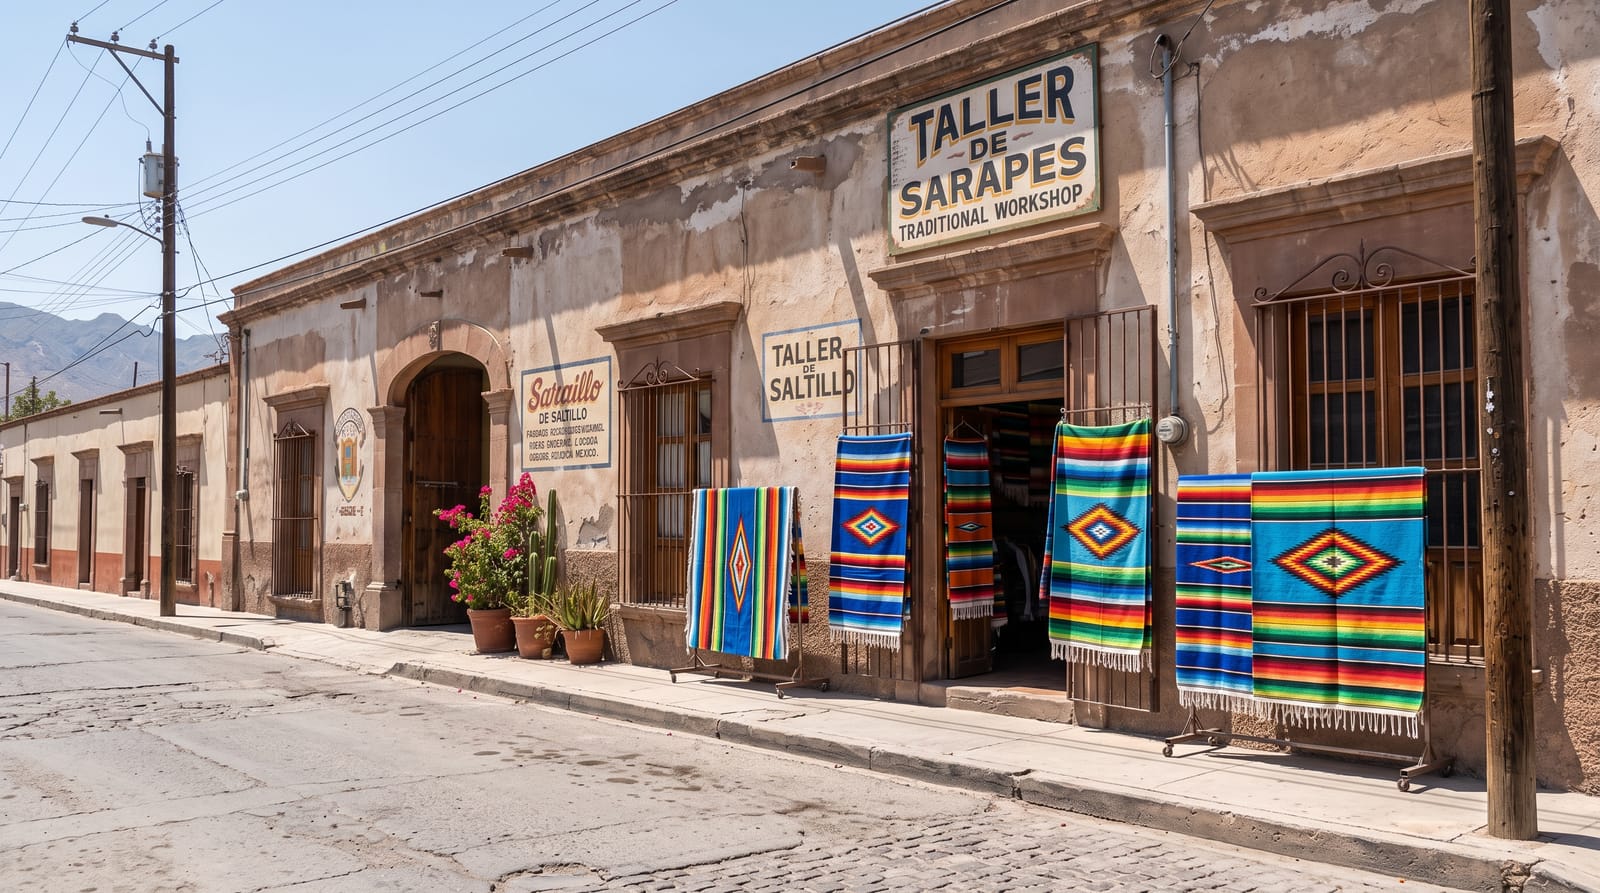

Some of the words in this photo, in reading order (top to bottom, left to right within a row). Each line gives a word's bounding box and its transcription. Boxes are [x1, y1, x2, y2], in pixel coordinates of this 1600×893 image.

[909, 65, 1075, 166] TALLER
[969, 131, 1008, 164] DE
[899, 137, 1087, 219] SARAPES
[899, 206, 989, 242] TRADITIONAL
[994, 183, 1083, 220] WORKSHOP
[772, 336, 842, 367] TALLER
[803, 364, 815, 373] DE
[539, 412, 549, 424] DE
[551, 407, 587, 423] SALTILLO
